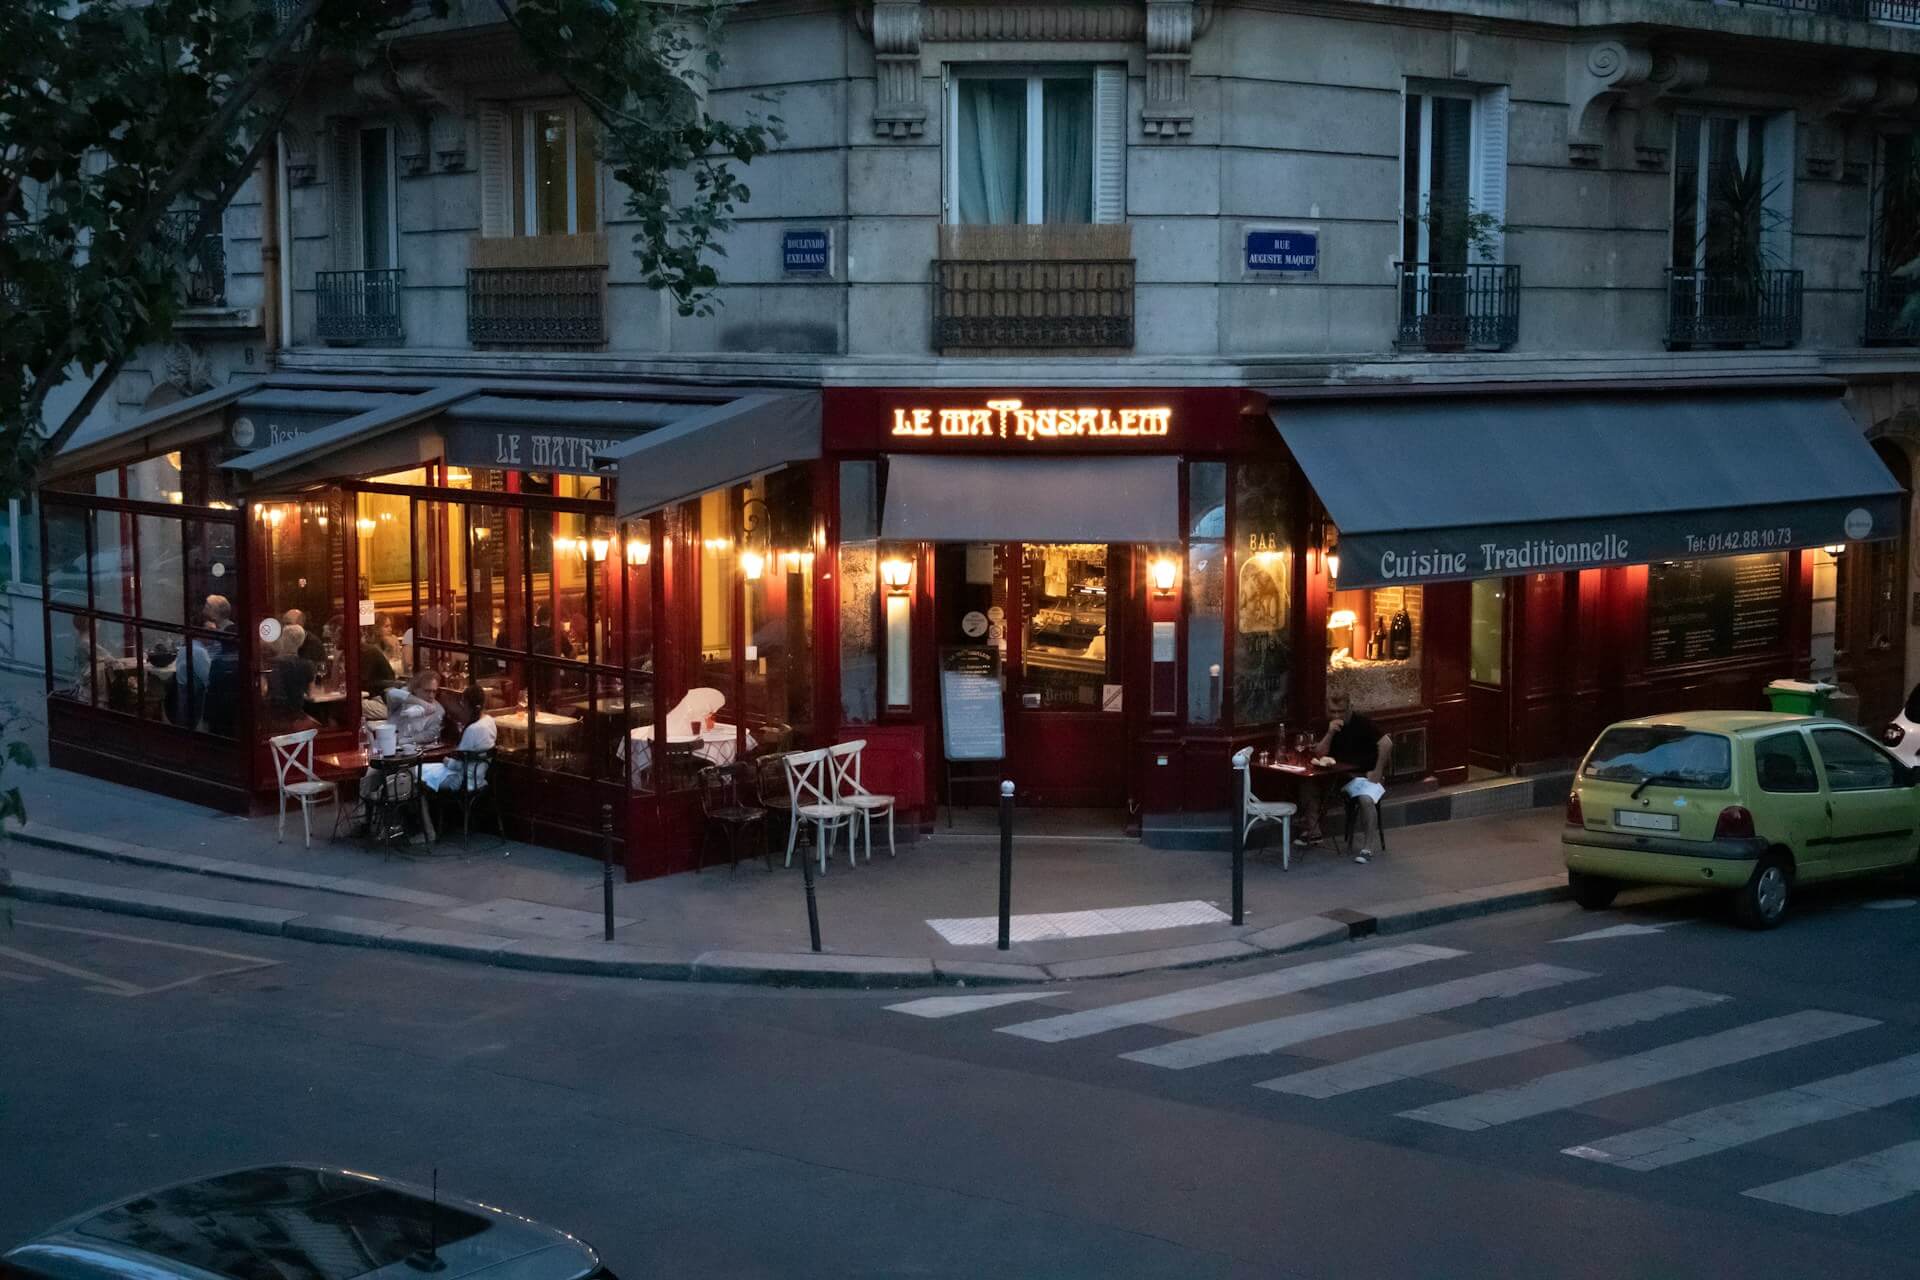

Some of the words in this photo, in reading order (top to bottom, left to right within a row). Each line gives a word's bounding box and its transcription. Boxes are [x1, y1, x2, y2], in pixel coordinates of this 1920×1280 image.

[787, 239, 825, 249] BOULEVARD
[1274, 239, 1291, 250] RUE
[786, 253, 825, 264] EXELMANS
[1248, 253, 1283, 265] AUGUSTE
[1284, 254, 1316, 267] MAQUET
[892, 408, 934, 436] LE
[938, 398, 1172, 441] MATHUSALEM
[496, 433, 521, 464] LE
[1250, 532, 1277, 551] BAR
[1708, 527, 1792, 551] 01.42.88.10.73
[1381, 548, 1467, 579] Cuisine
[1480, 534, 1629, 570] Traditionnelle
